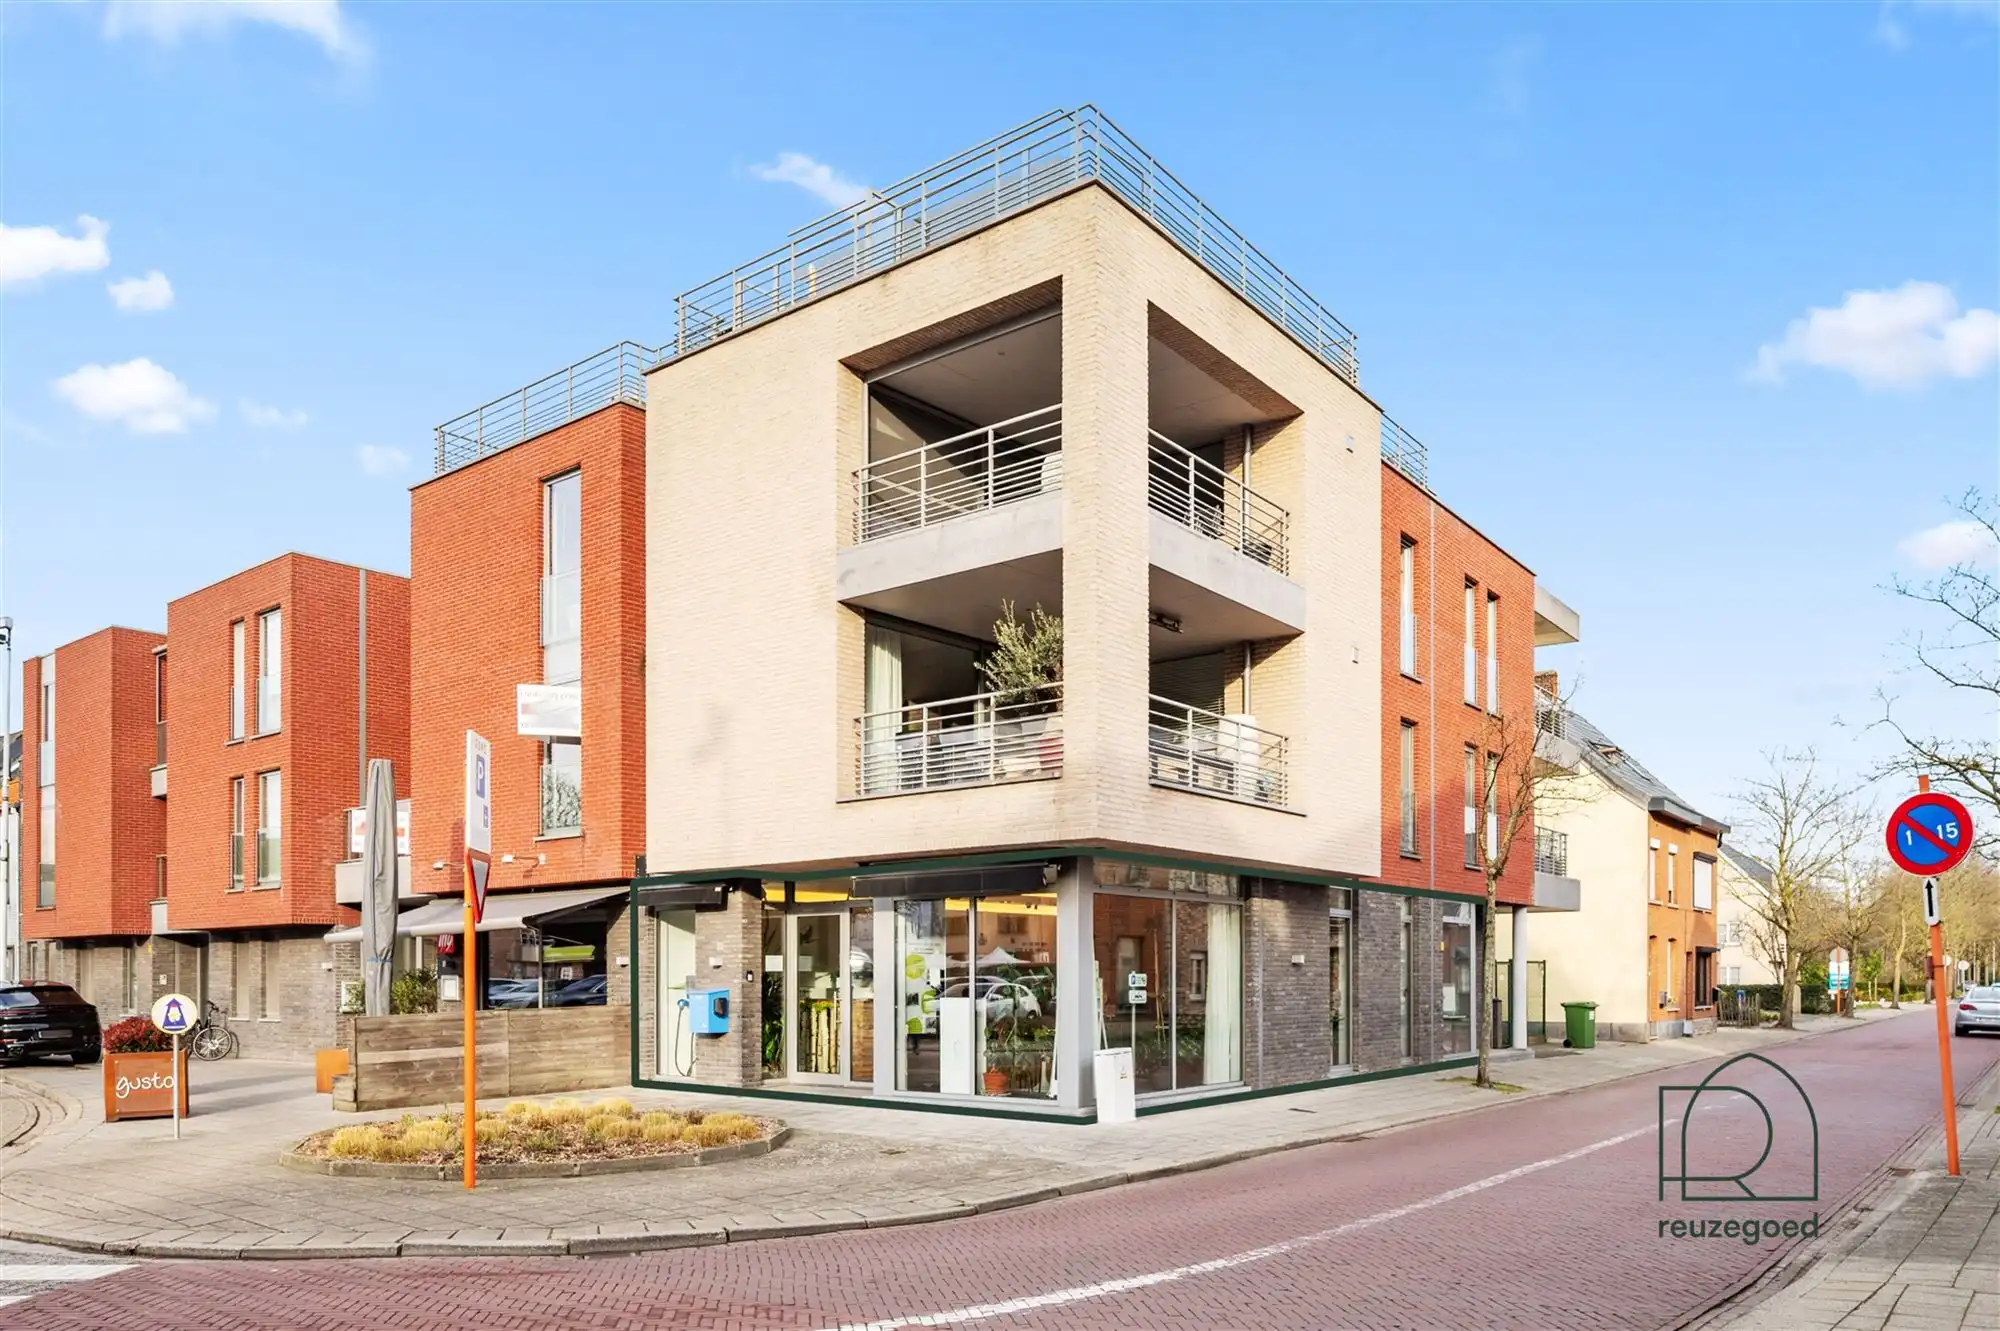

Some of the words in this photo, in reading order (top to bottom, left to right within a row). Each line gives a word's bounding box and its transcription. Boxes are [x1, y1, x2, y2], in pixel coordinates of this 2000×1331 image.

[477, 760, 484, 791] P
[1905, 829, 1913, 846] 1
[1936, 821, 1959, 840] 15
[115, 1072, 175, 1099] gusto
